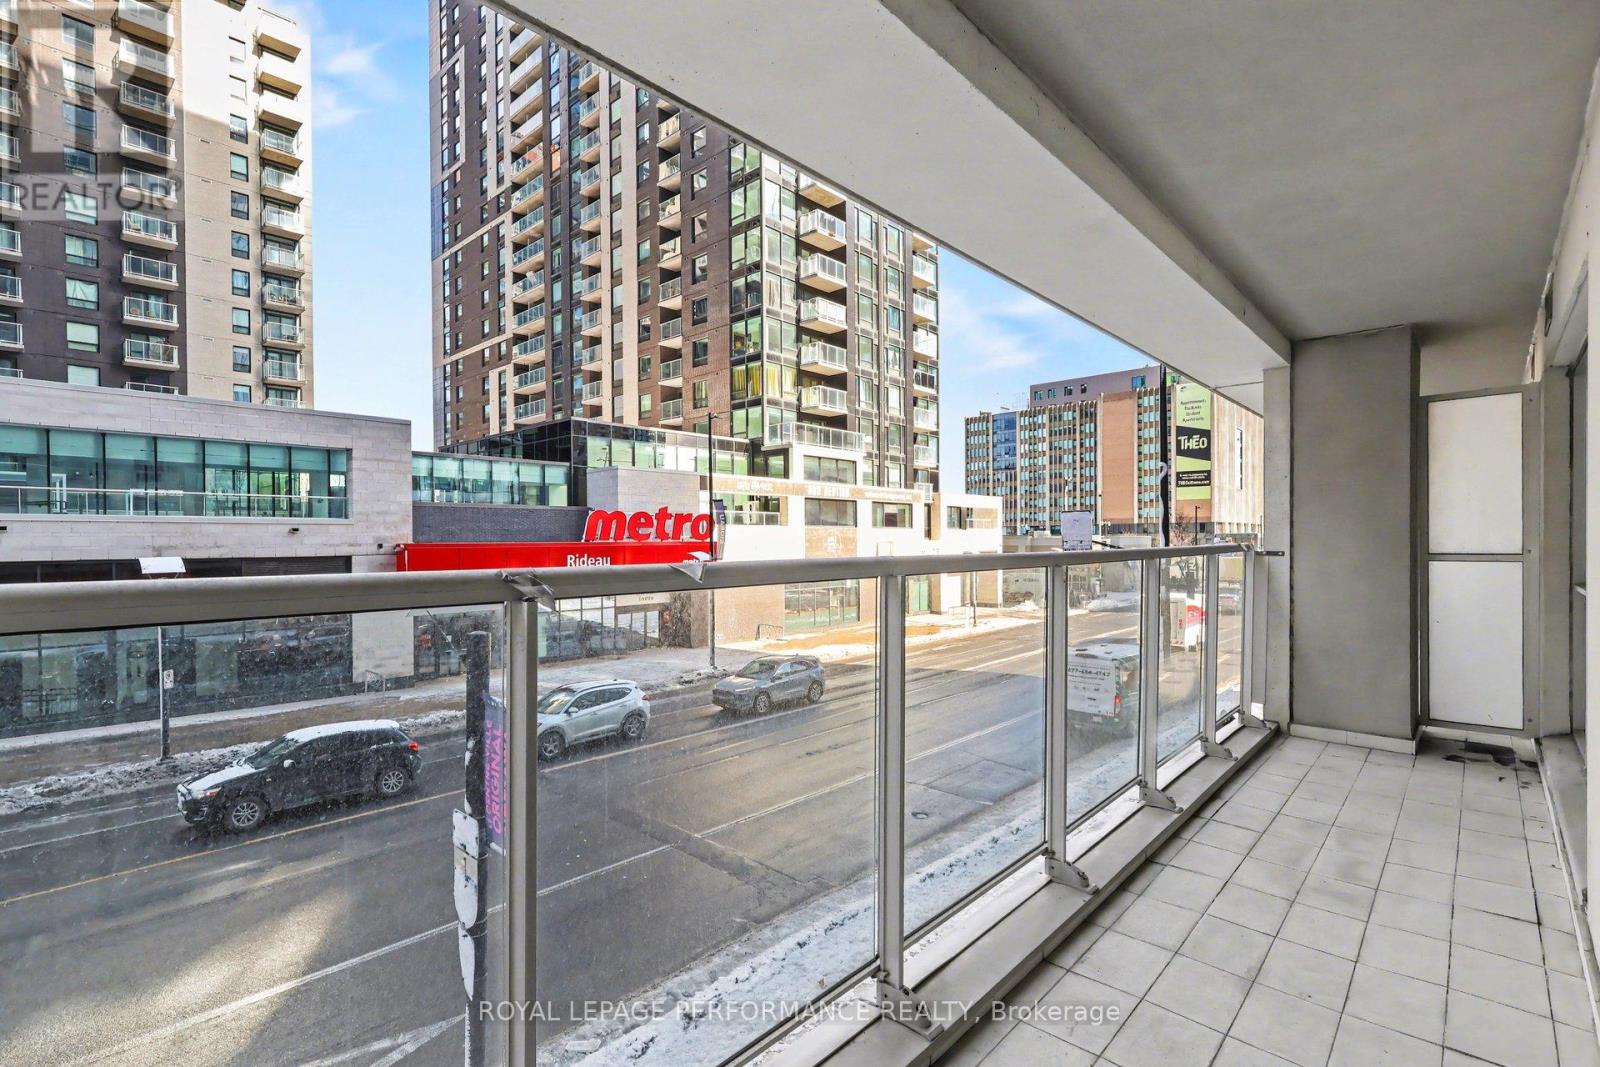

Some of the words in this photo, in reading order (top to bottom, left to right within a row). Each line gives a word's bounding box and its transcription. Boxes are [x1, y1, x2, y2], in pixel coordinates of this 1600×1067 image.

[585, 506, 715, 542] metro
[567, 554, 611, 566] Rideau
[491, 725, 503, 834] ORIGINAL
